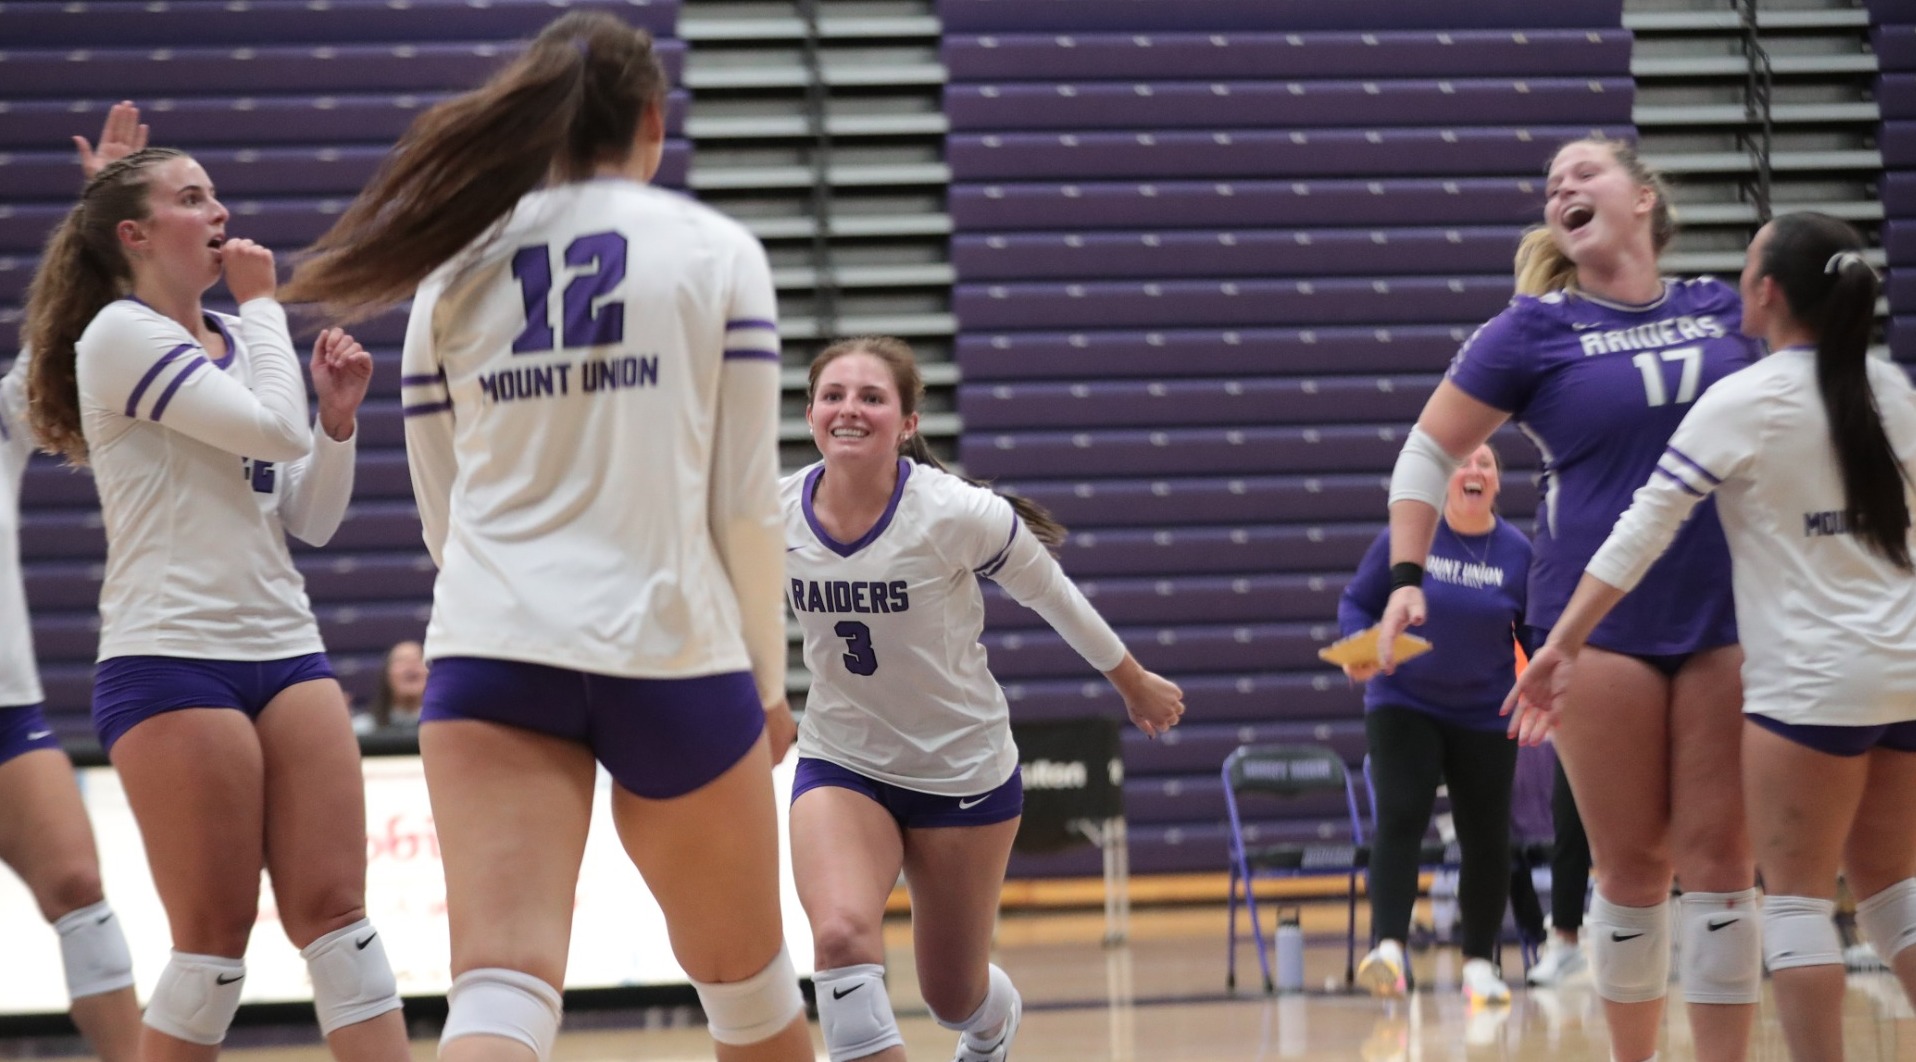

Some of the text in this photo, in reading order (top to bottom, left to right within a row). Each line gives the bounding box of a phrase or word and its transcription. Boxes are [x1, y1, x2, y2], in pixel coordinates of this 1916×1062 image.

[511, 230, 627, 356] 12
[1580, 316, 1724, 356] RAIDERS
[479, 354, 659, 404] MOUNT UNION
[1632, 346, 1703, 408] 17
[241, 456, 276, 494] 2
[1803, 509, 1848, 538] MOU
[1426, 554, 1461, 581] OUNT
[791, 577, 910, 614] RAIDERS
[833, 620, 879, 677] 3
